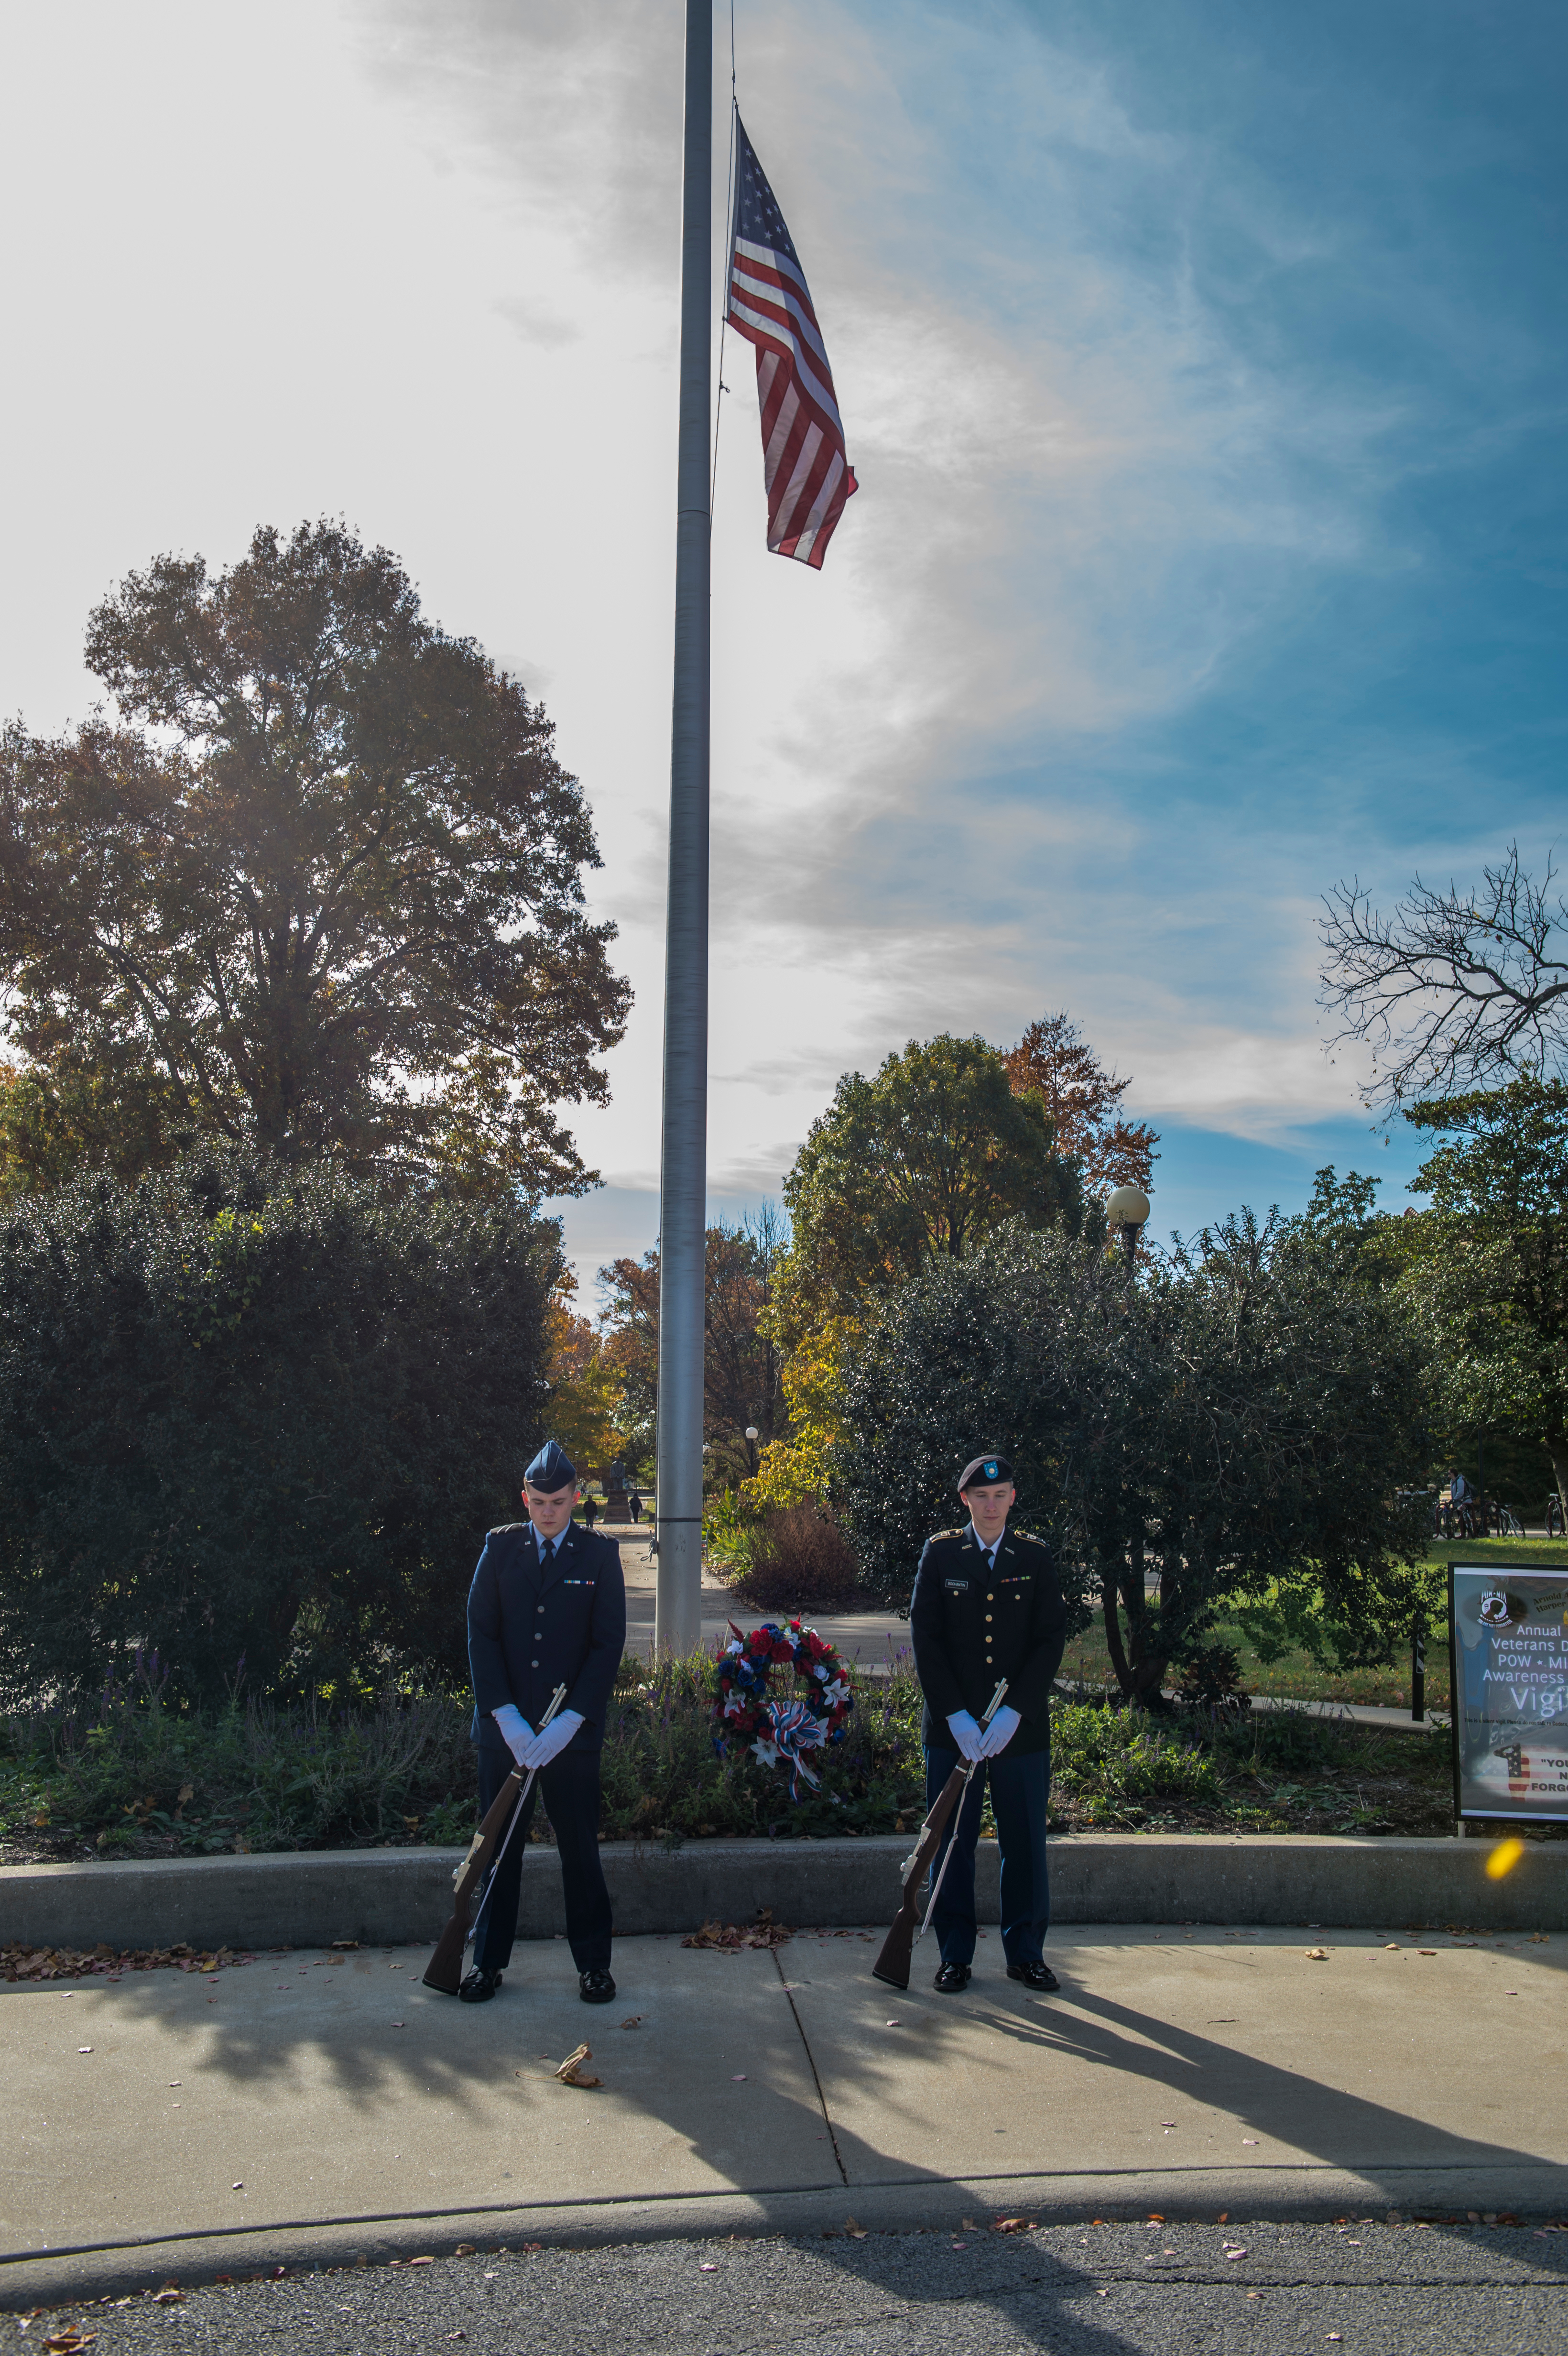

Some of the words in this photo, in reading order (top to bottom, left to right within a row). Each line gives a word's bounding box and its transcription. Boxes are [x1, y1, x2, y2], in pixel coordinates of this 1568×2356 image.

[1481, 1591, 1492, 1603] POW
[1496, 1591, 1507, 1604] MIA
[1533, 1592, 1561, 1605] Arnold
[1535, 1602, 1566, 1613] Harper
[1517, 1625, 1561, 1636] Annual
[1492, 1638, 1555, 1651] Veterans
[1499, 1655, 1531, 1667] POW
[1483, 1669, 1564, 1683] Awareness
[1511, 1687, 1568, 1717] Vigi
[1531, 1783, 1568, 1792] FORG
